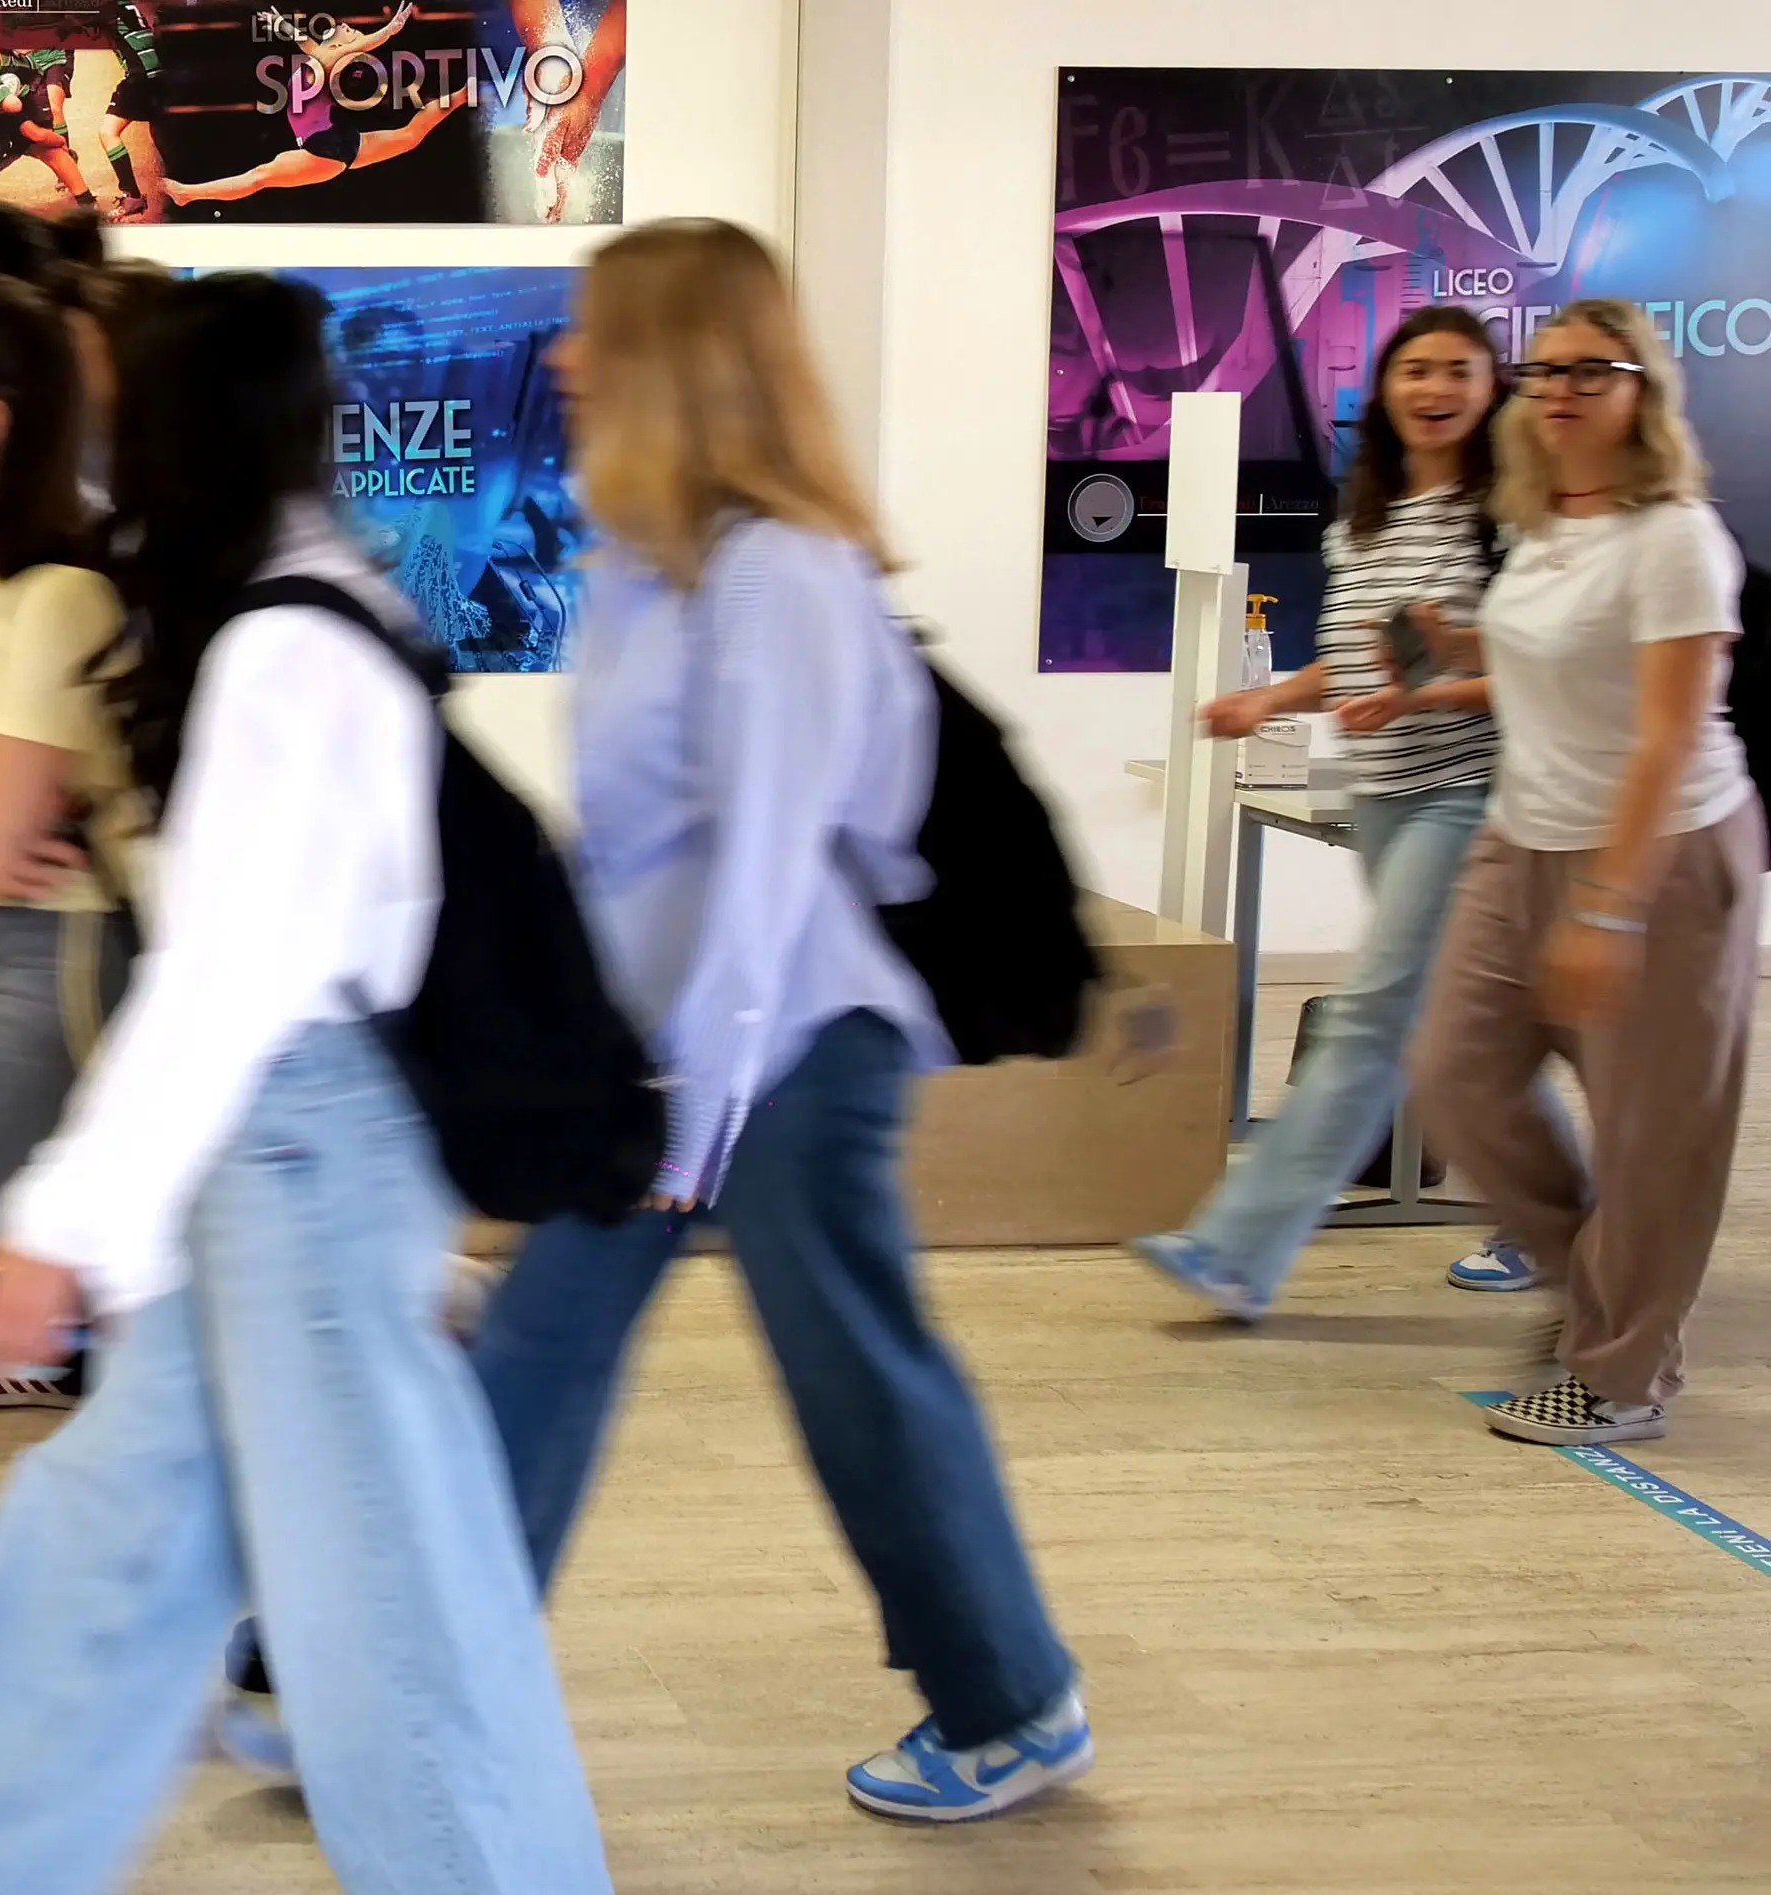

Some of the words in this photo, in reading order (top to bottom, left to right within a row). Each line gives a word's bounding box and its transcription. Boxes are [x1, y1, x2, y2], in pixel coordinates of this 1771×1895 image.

[251, 12, 337, 43] LICEO
[255, 45, 583, 115] SPORTIVO
[1433, 267, 1514, 297] LICEO
[332, 400, 472, 463] ENZE
[332, 466, 475, 498] APPLICATE
[1676, 1507, 1722, 1526] LA
